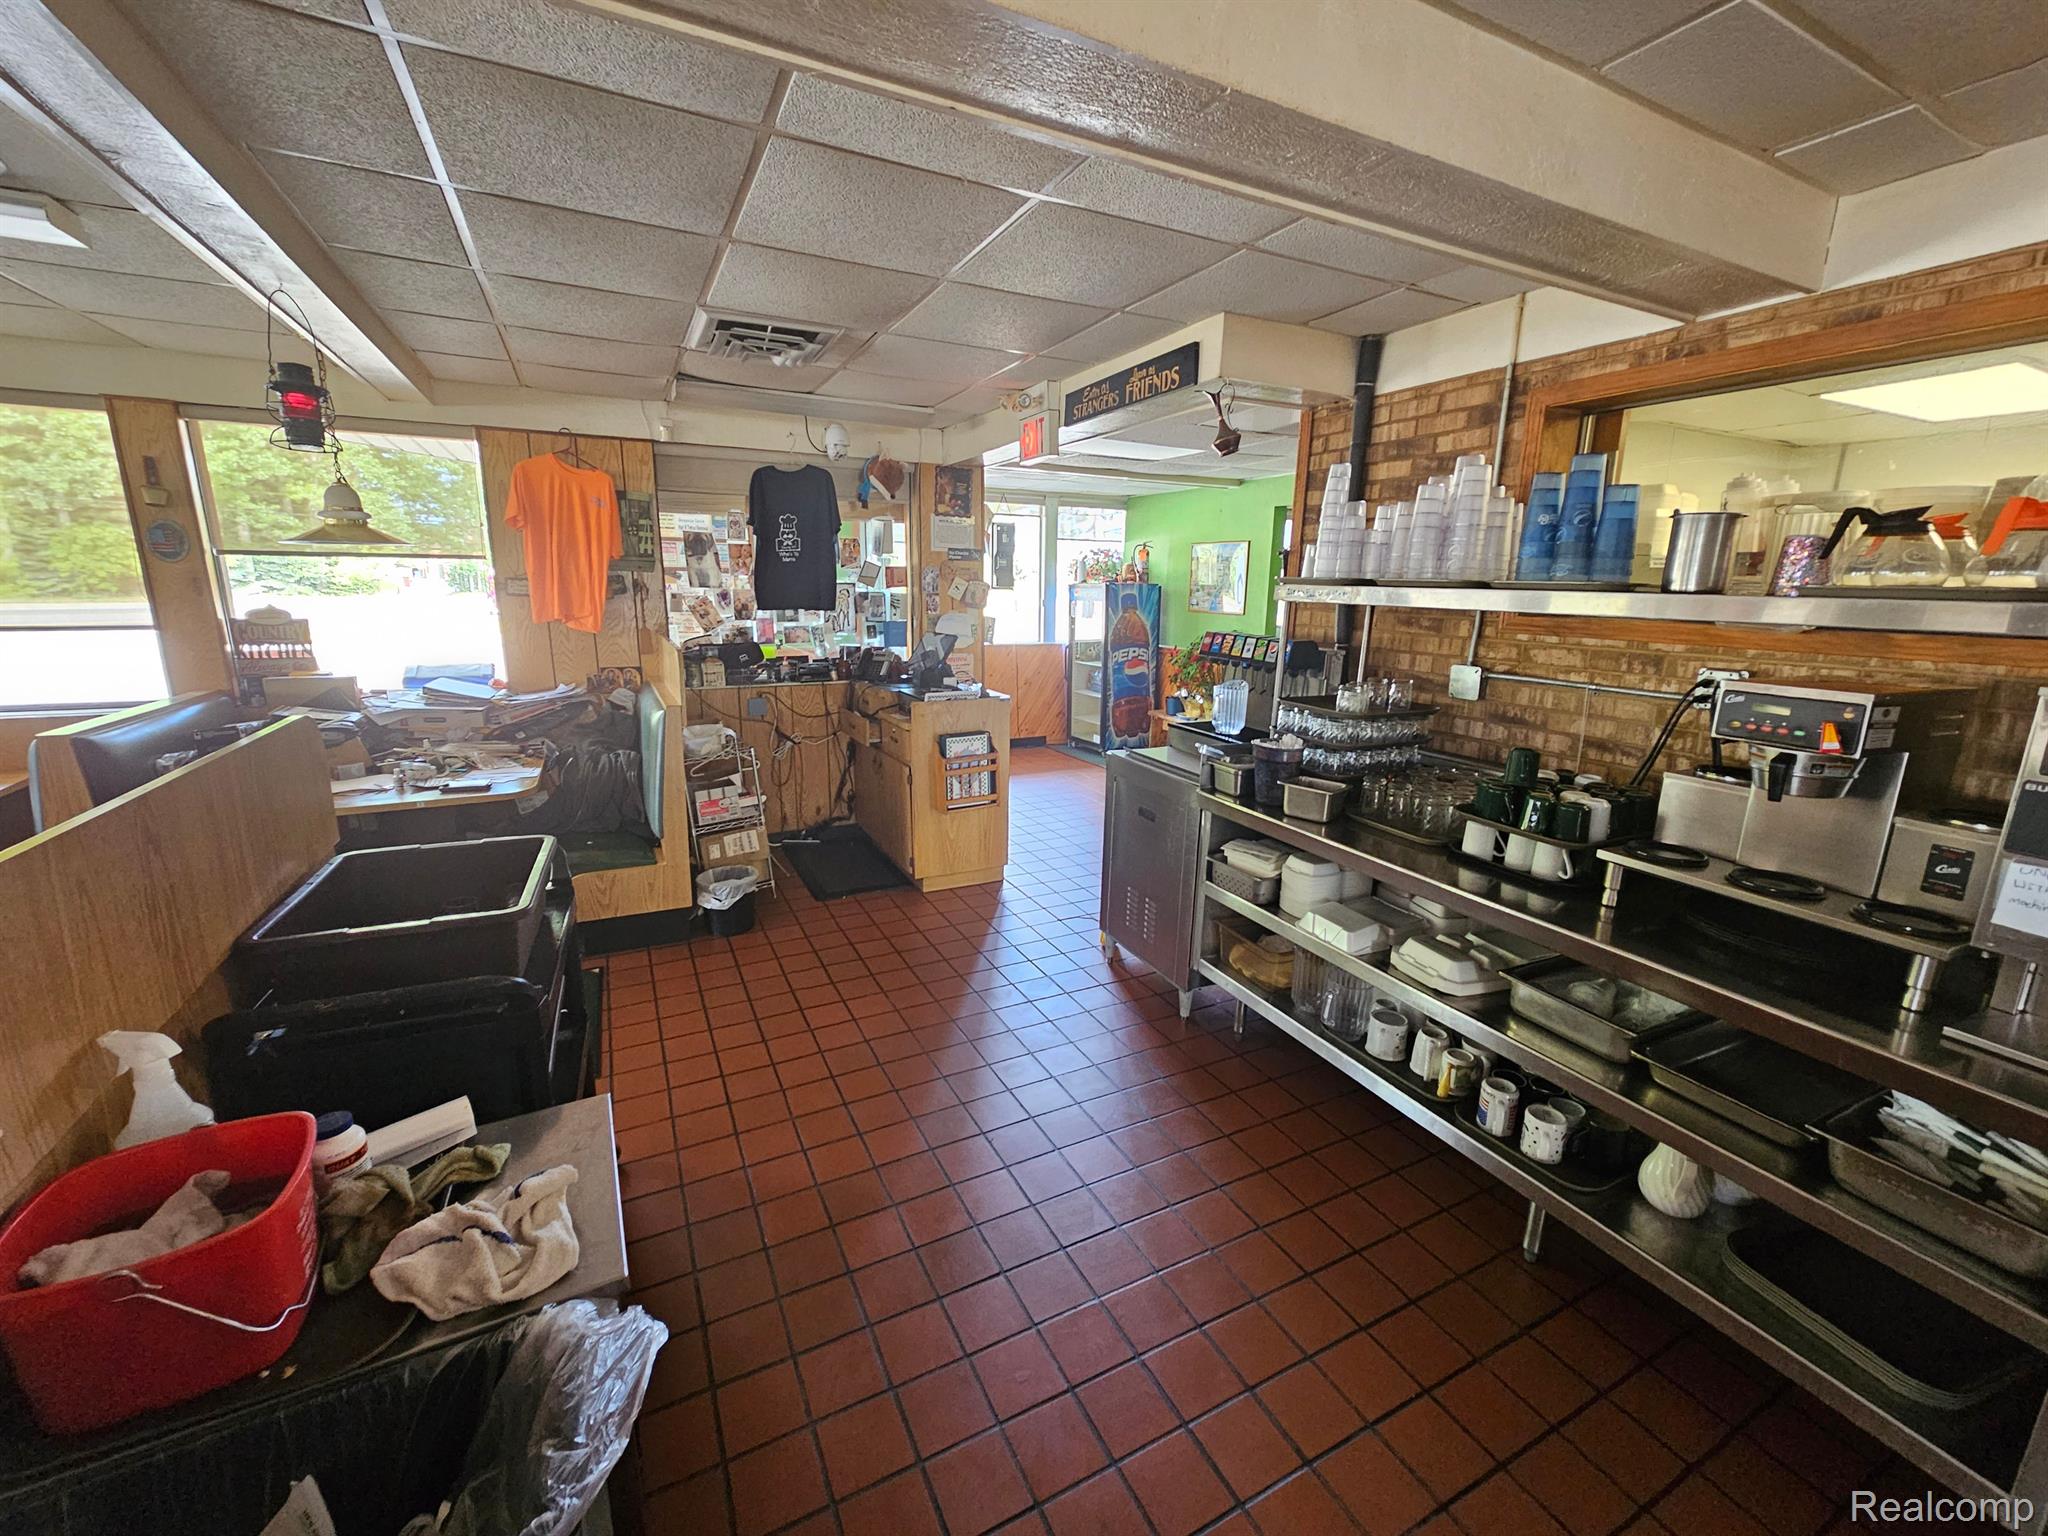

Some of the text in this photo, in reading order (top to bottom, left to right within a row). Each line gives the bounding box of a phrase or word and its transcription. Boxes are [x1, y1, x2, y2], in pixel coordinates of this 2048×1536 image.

[1125, 366, 1180, 404] FRIENDS
[1073, 391, 1120, 420] STRANGERS
[1023, 416, 1045, 459] EIT
[237, 622, 306, 640] COUNTRY
